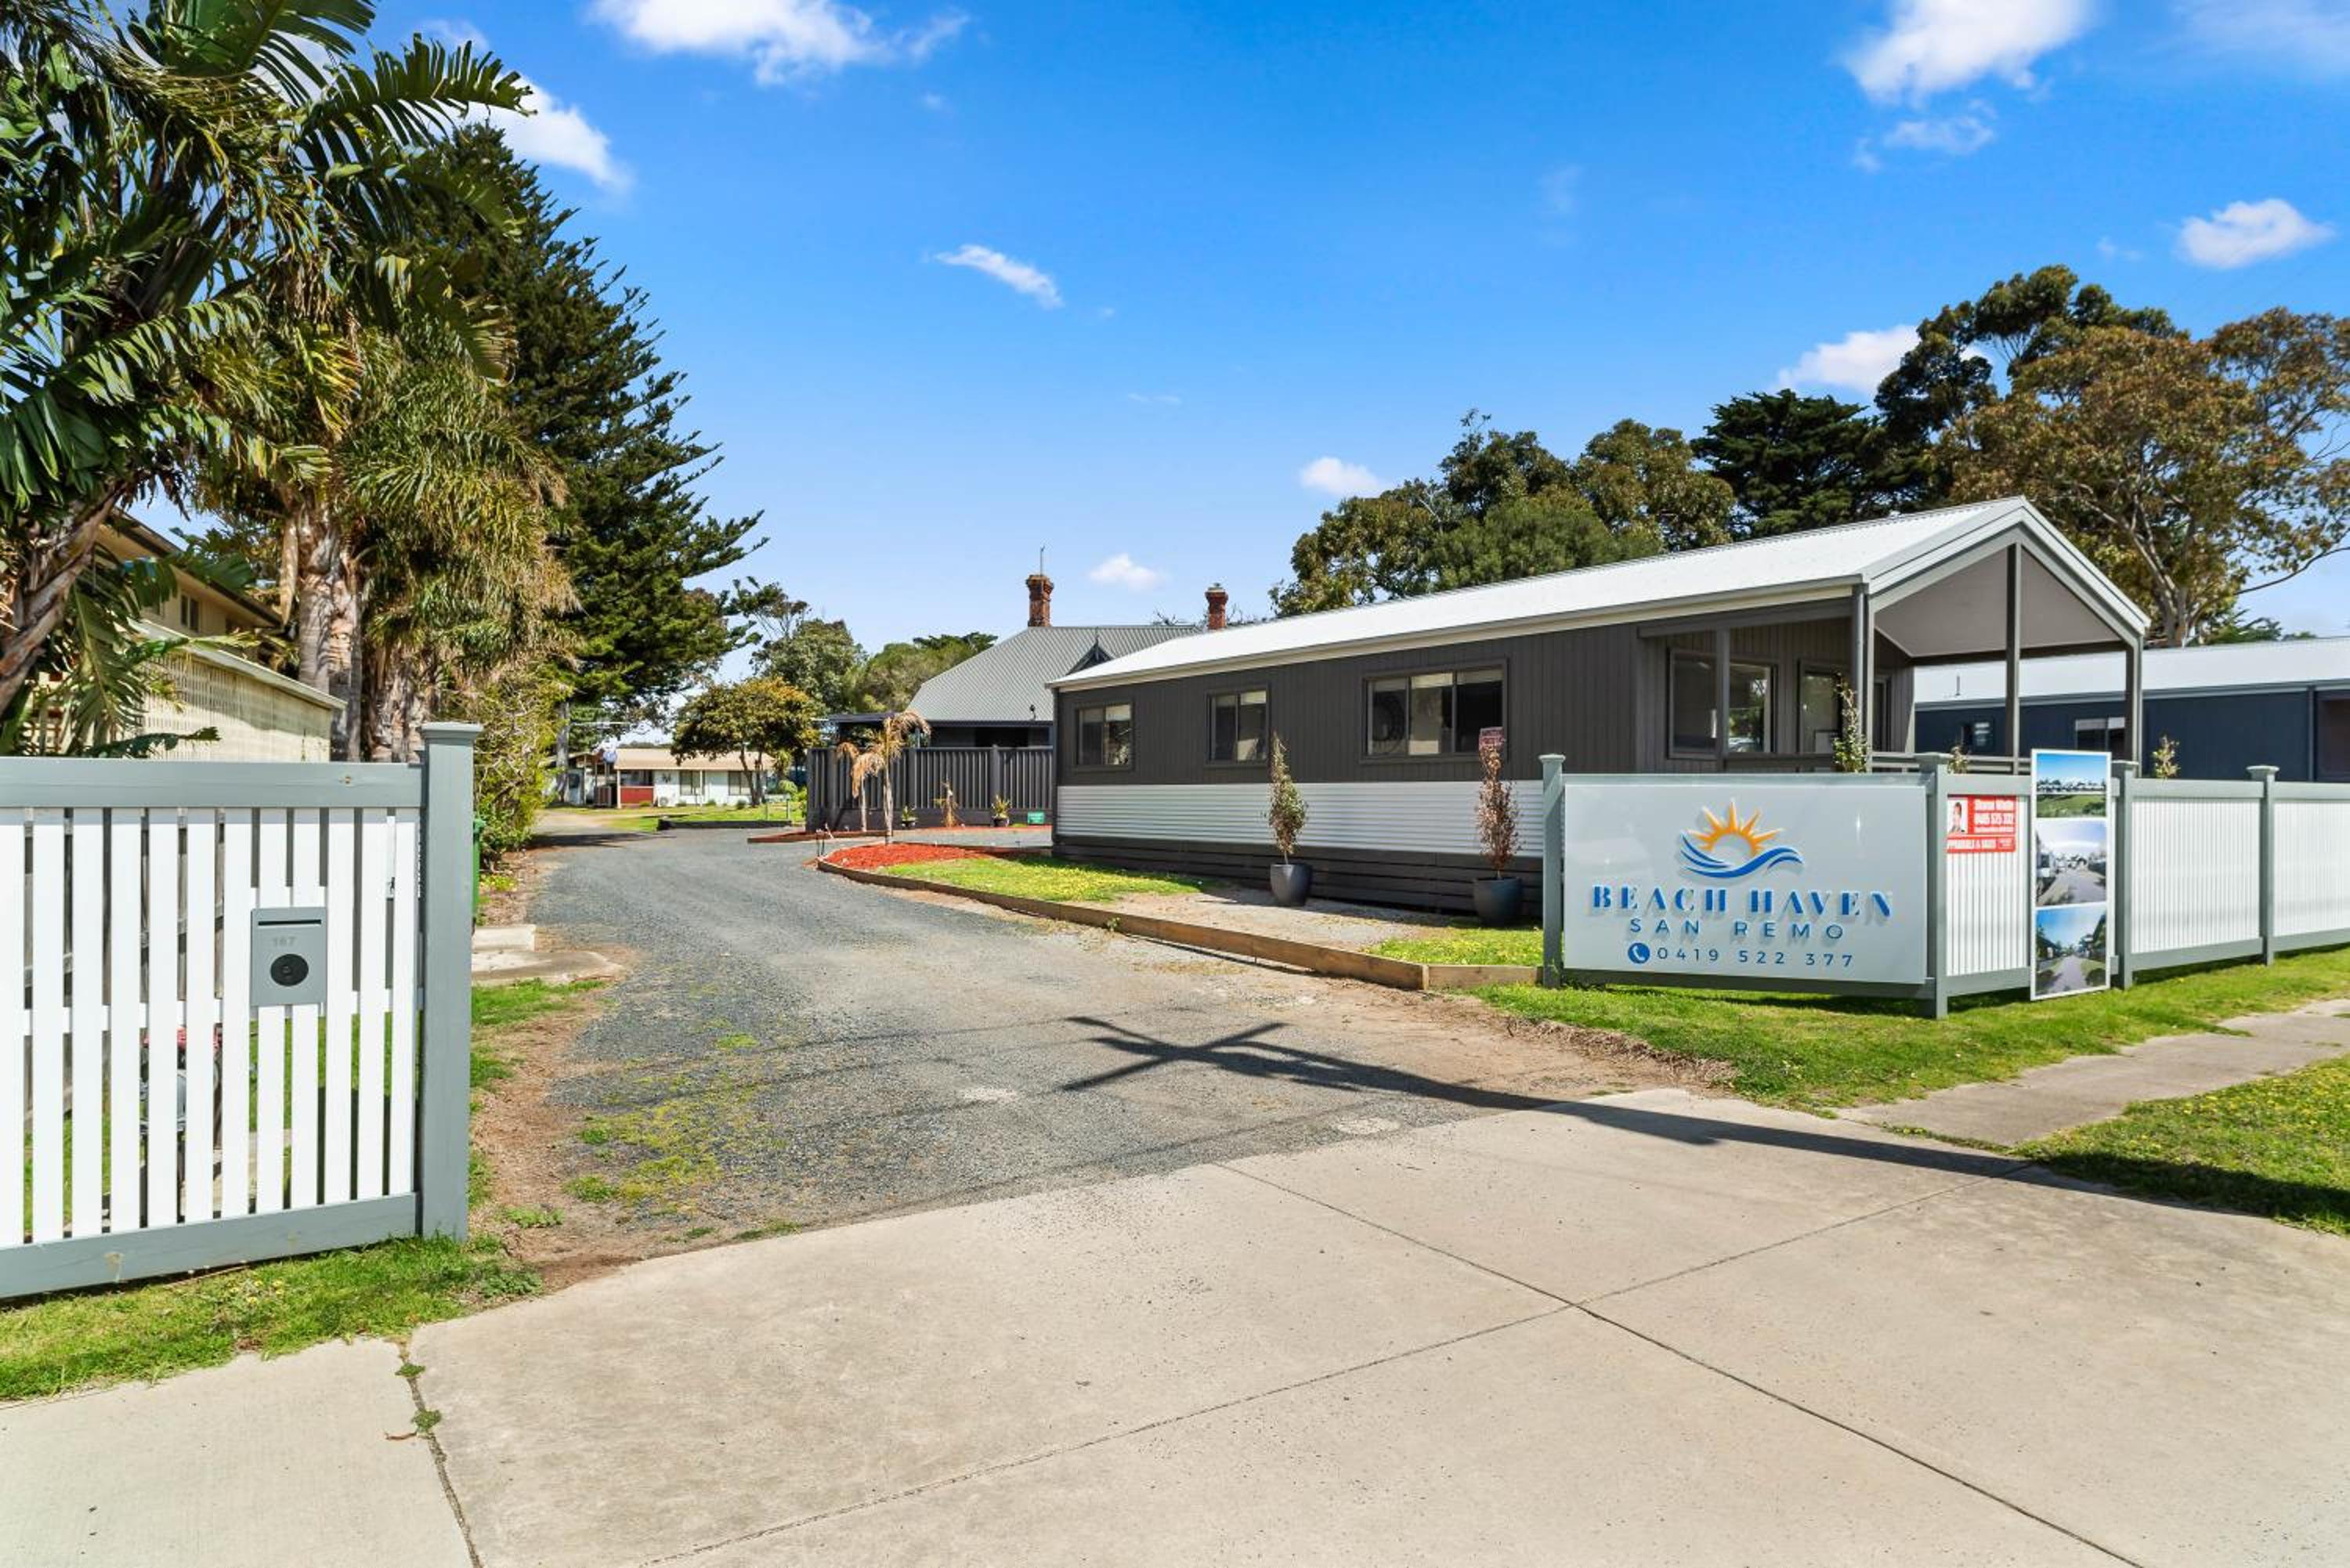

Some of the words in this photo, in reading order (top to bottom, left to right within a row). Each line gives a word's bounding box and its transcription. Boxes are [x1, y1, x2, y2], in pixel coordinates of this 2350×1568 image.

[1593, 885, 1727, 912] BEACH
[1750, 889, 1893, 917] HAVEN
[1629, 918, 1700, 934] SAN
[1734, 921, 1843, 940] REMO
[1657, 947, 1719, 961] 0419
[1738, 950, 1784, 964] 522
[1805, 953, 1853, 967] 377
